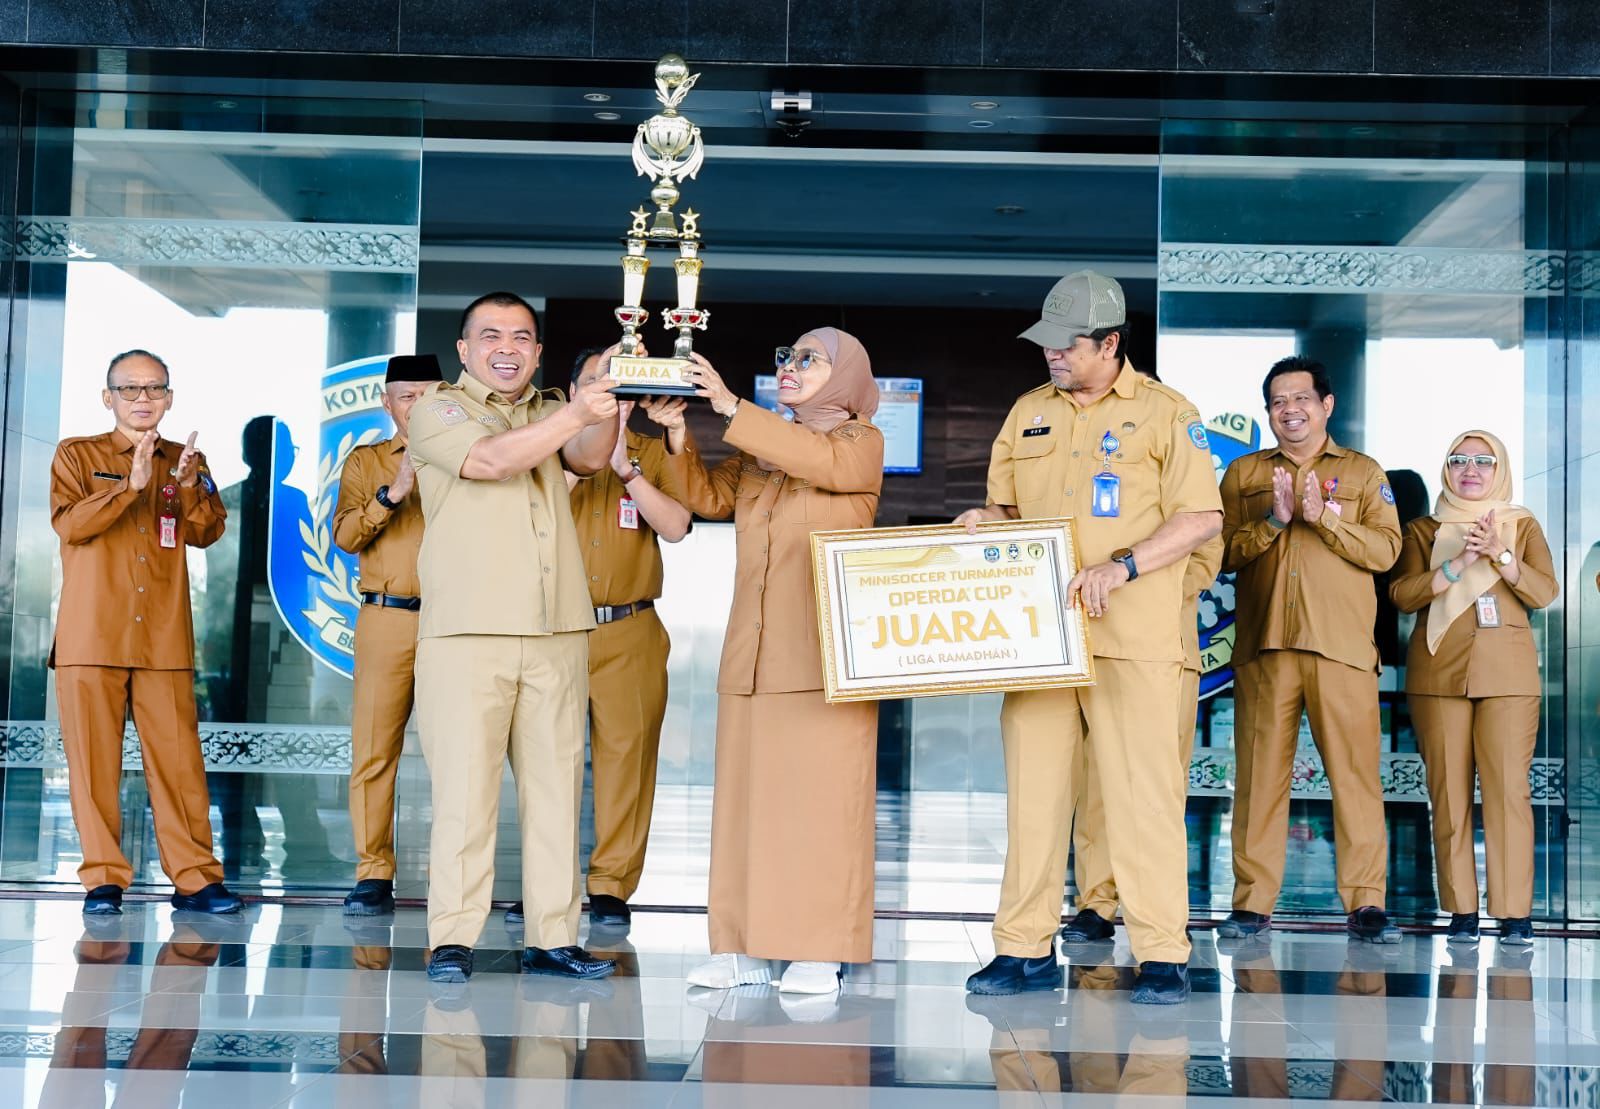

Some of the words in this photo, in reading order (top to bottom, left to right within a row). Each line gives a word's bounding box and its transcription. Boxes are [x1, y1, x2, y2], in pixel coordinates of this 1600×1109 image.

[616, 365, 671, 378] JUARA
[324, 382, 383, 412] KOTA
[859, 571, 945, 587] MINISOCCER
[950, 566, 1036, 581] TURNAMENT
[888, 588, 971, 607] OPERDA
[975, 585, 1012, 601] CUP
[872, 608, 1010, 649] JUARA
[1022, 606, 1039, 637] 1
